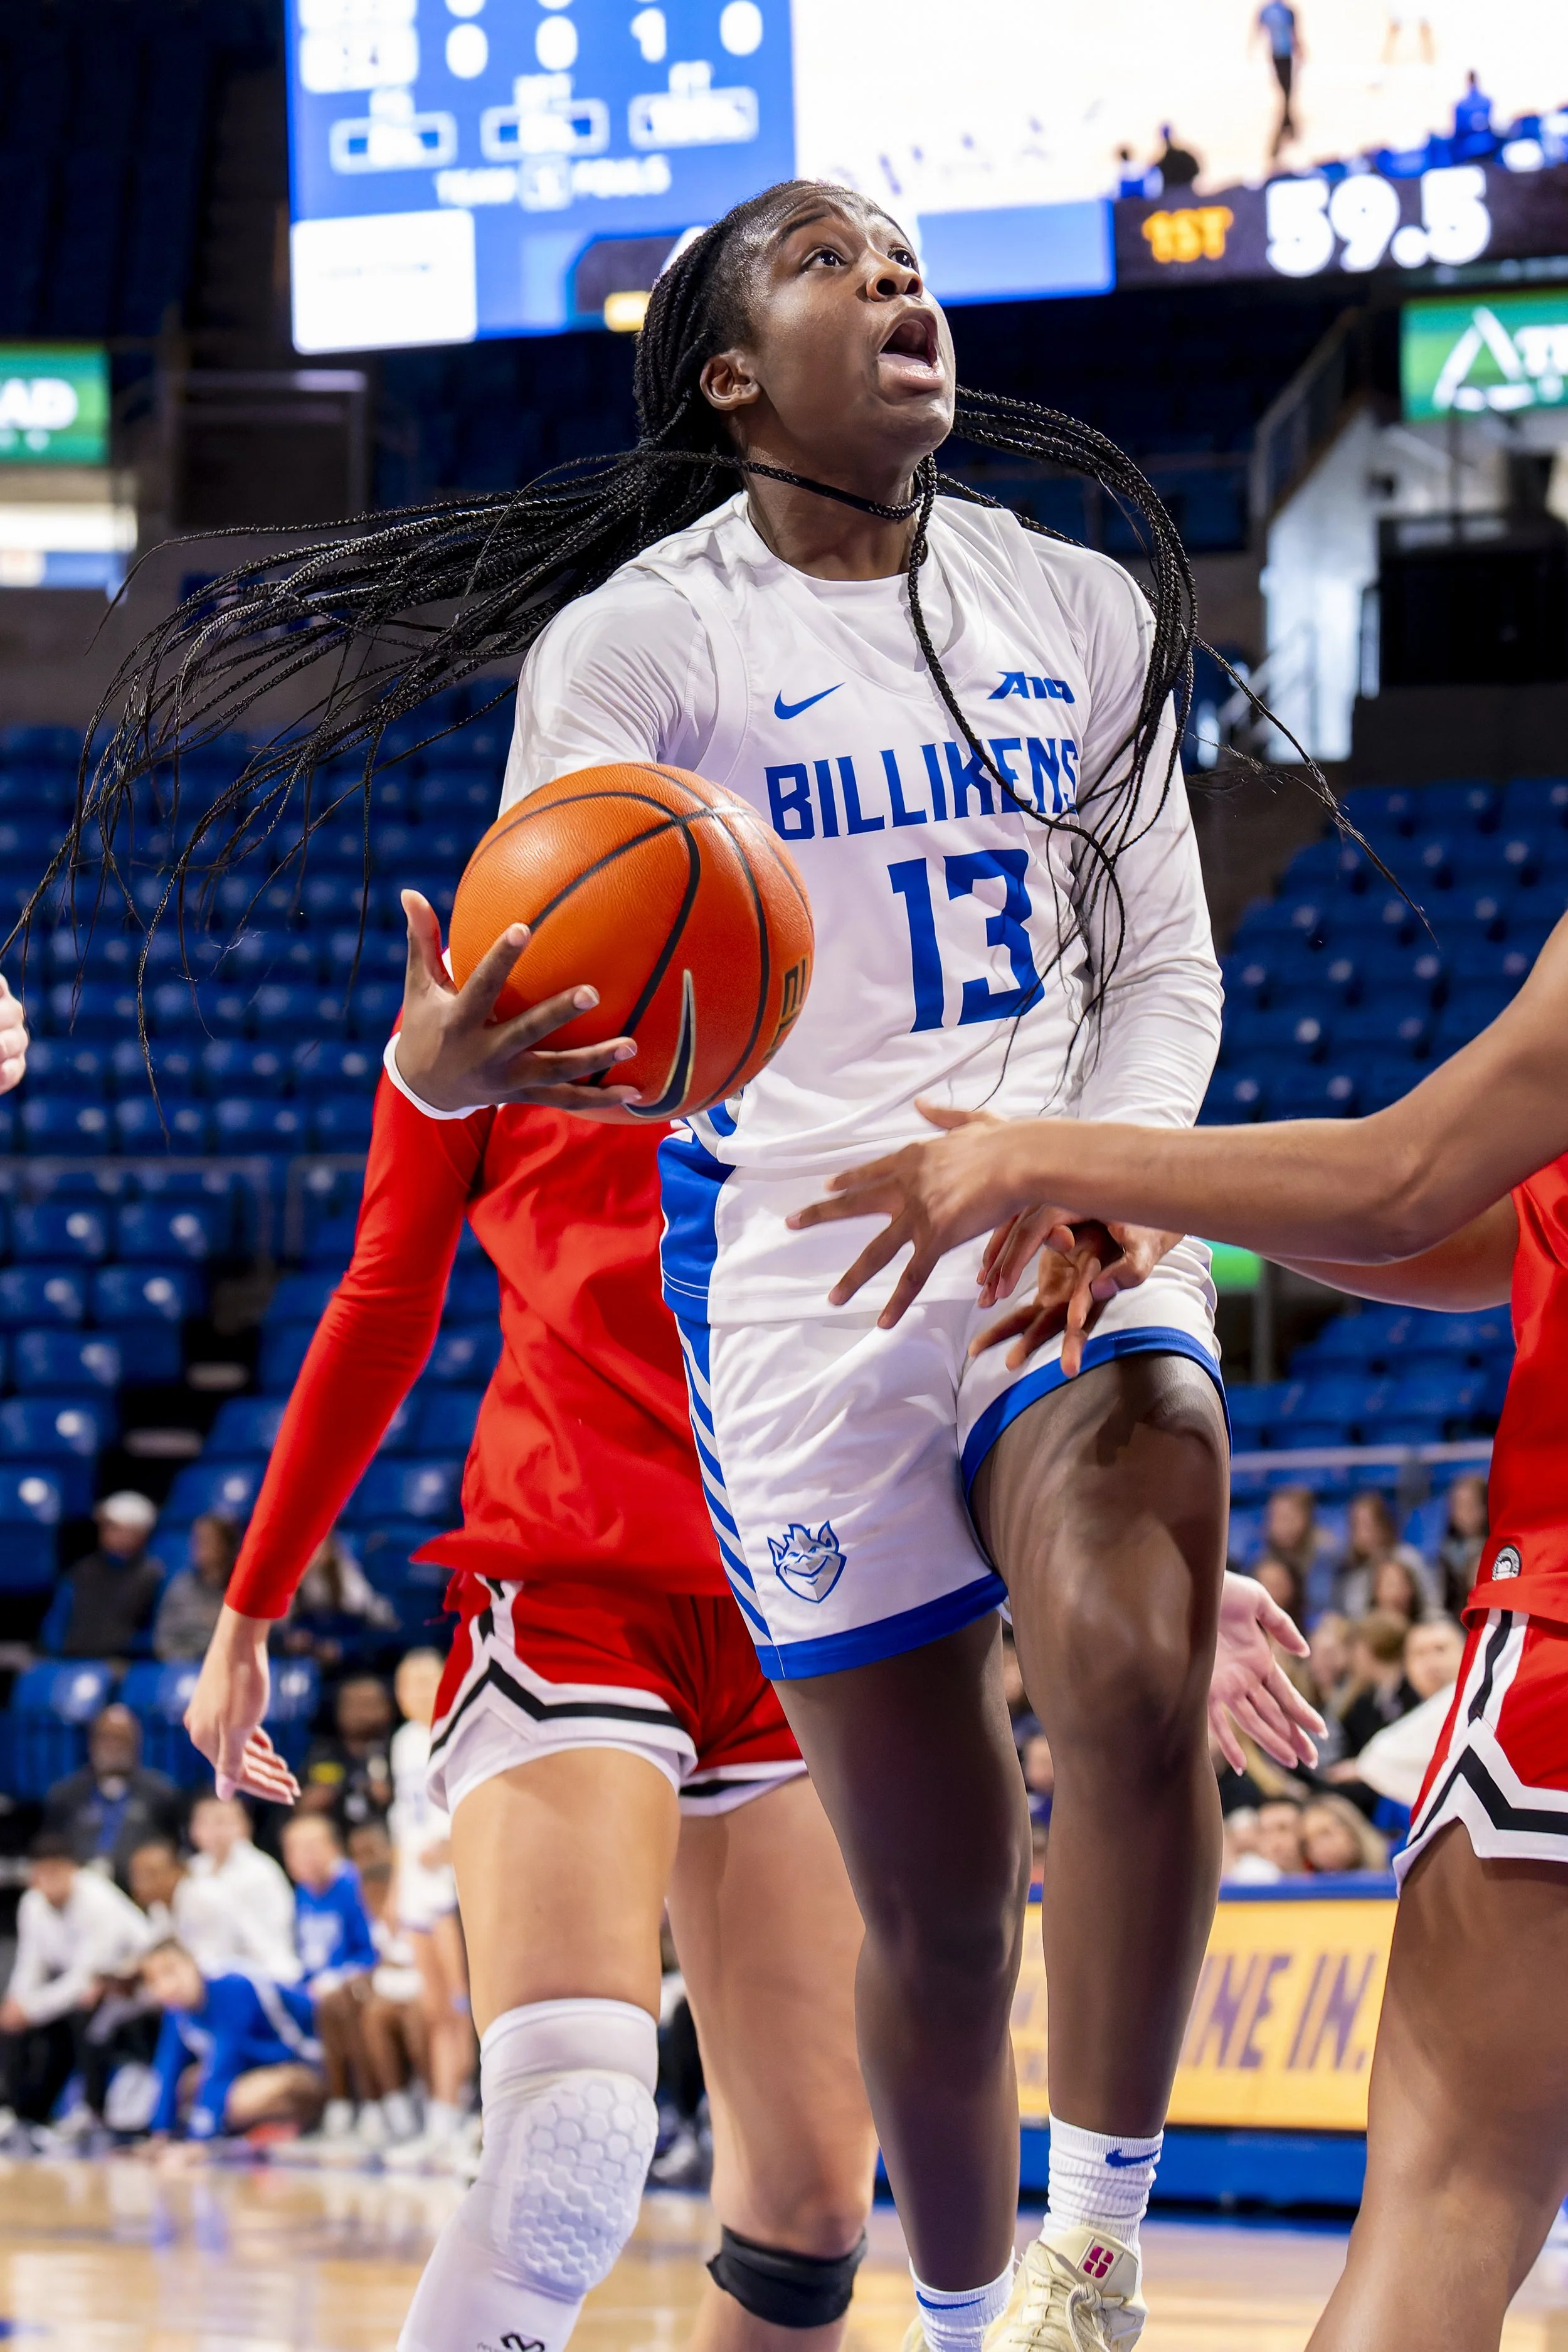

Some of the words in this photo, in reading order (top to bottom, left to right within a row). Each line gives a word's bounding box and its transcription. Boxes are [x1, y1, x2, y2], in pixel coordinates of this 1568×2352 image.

[1142, 206, 1234, 263] 1ST
[1265, 166, 1491, 277] 59.5
[987, 671, 1075, 704] A10
[763, 736, 1079, 840] BILLIKENS
[887, 849, 1045, 1033] 13
